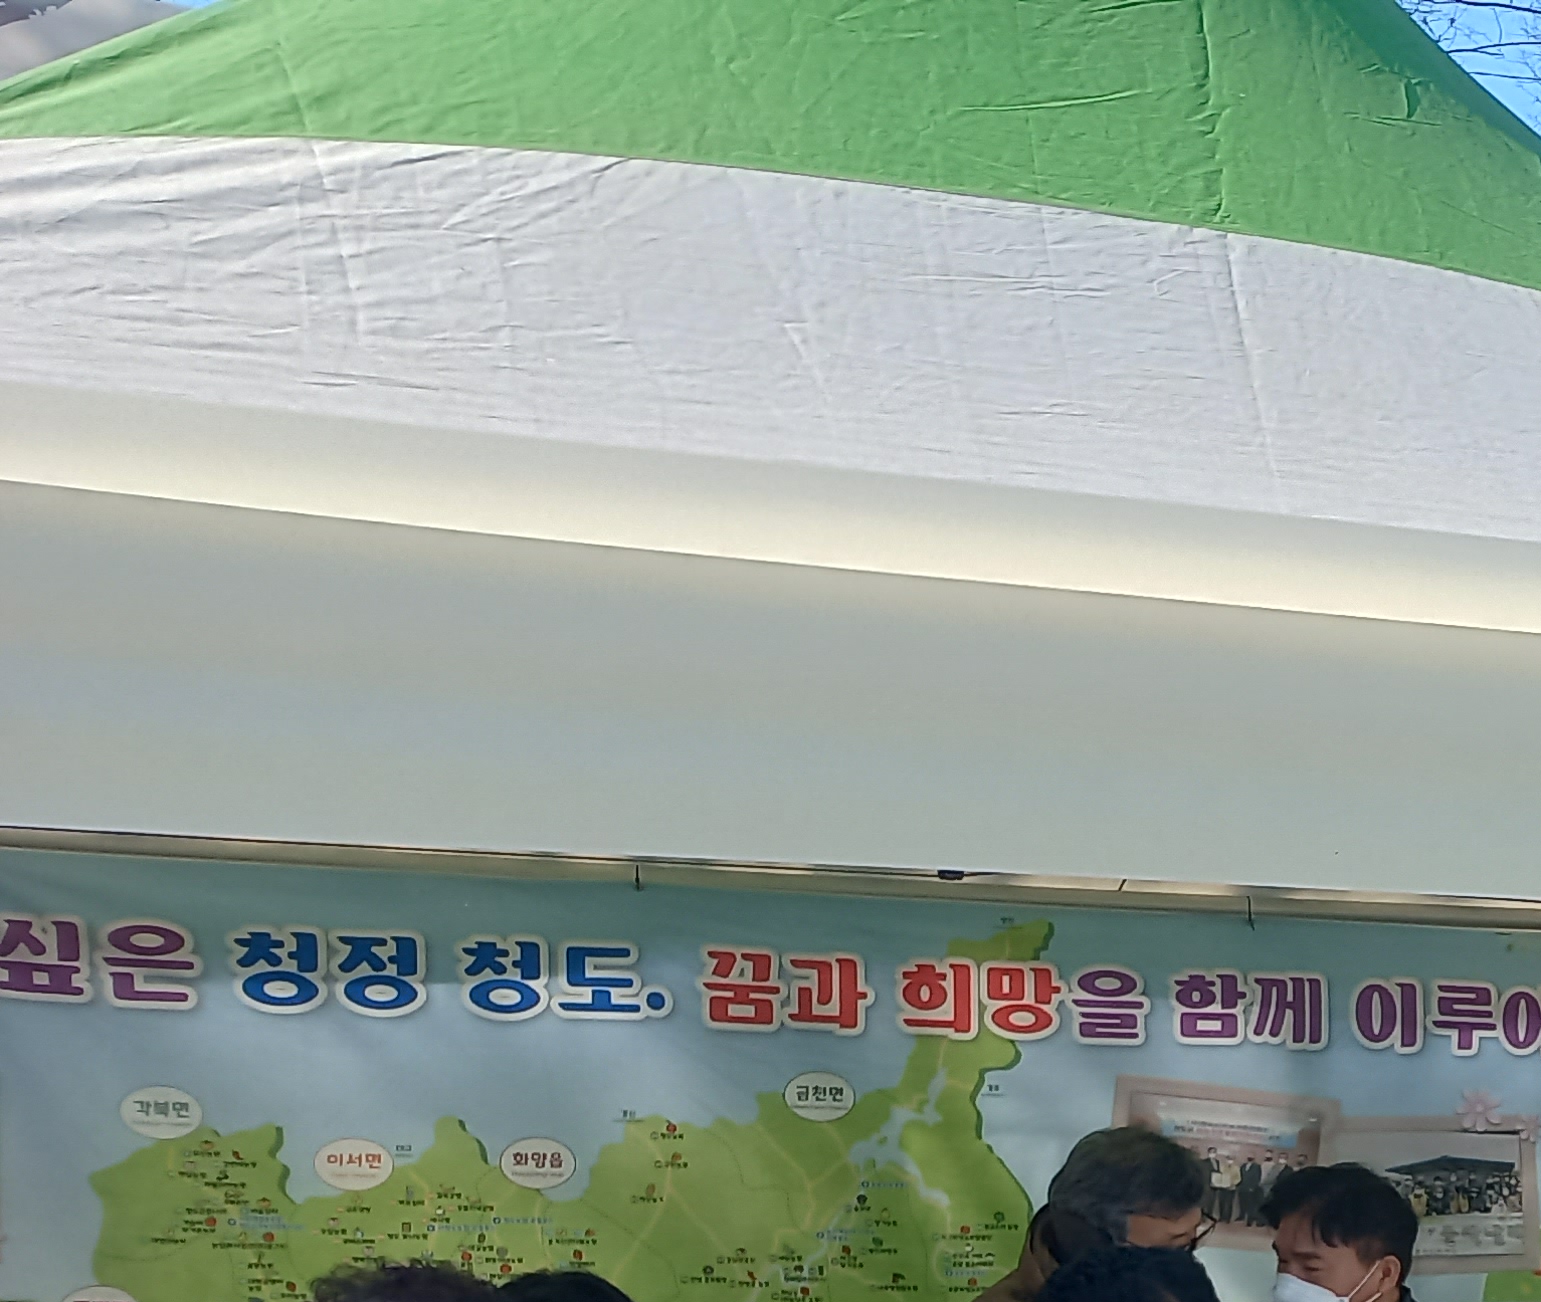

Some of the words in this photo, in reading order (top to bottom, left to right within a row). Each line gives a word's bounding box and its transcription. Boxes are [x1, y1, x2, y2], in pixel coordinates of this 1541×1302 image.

[0, 917, 197, 1006] 싶은
[234, 930, 422, 1015] 청정
[702, 948, 870, 1032] 꿈과
[902, 959, 1147, 1044] 희망을
[1173, 972, 1325, 1047] 함께
[326, 1152, 383, 1169] 이서면
[511, 1151, 564, 1169] 화양읍
